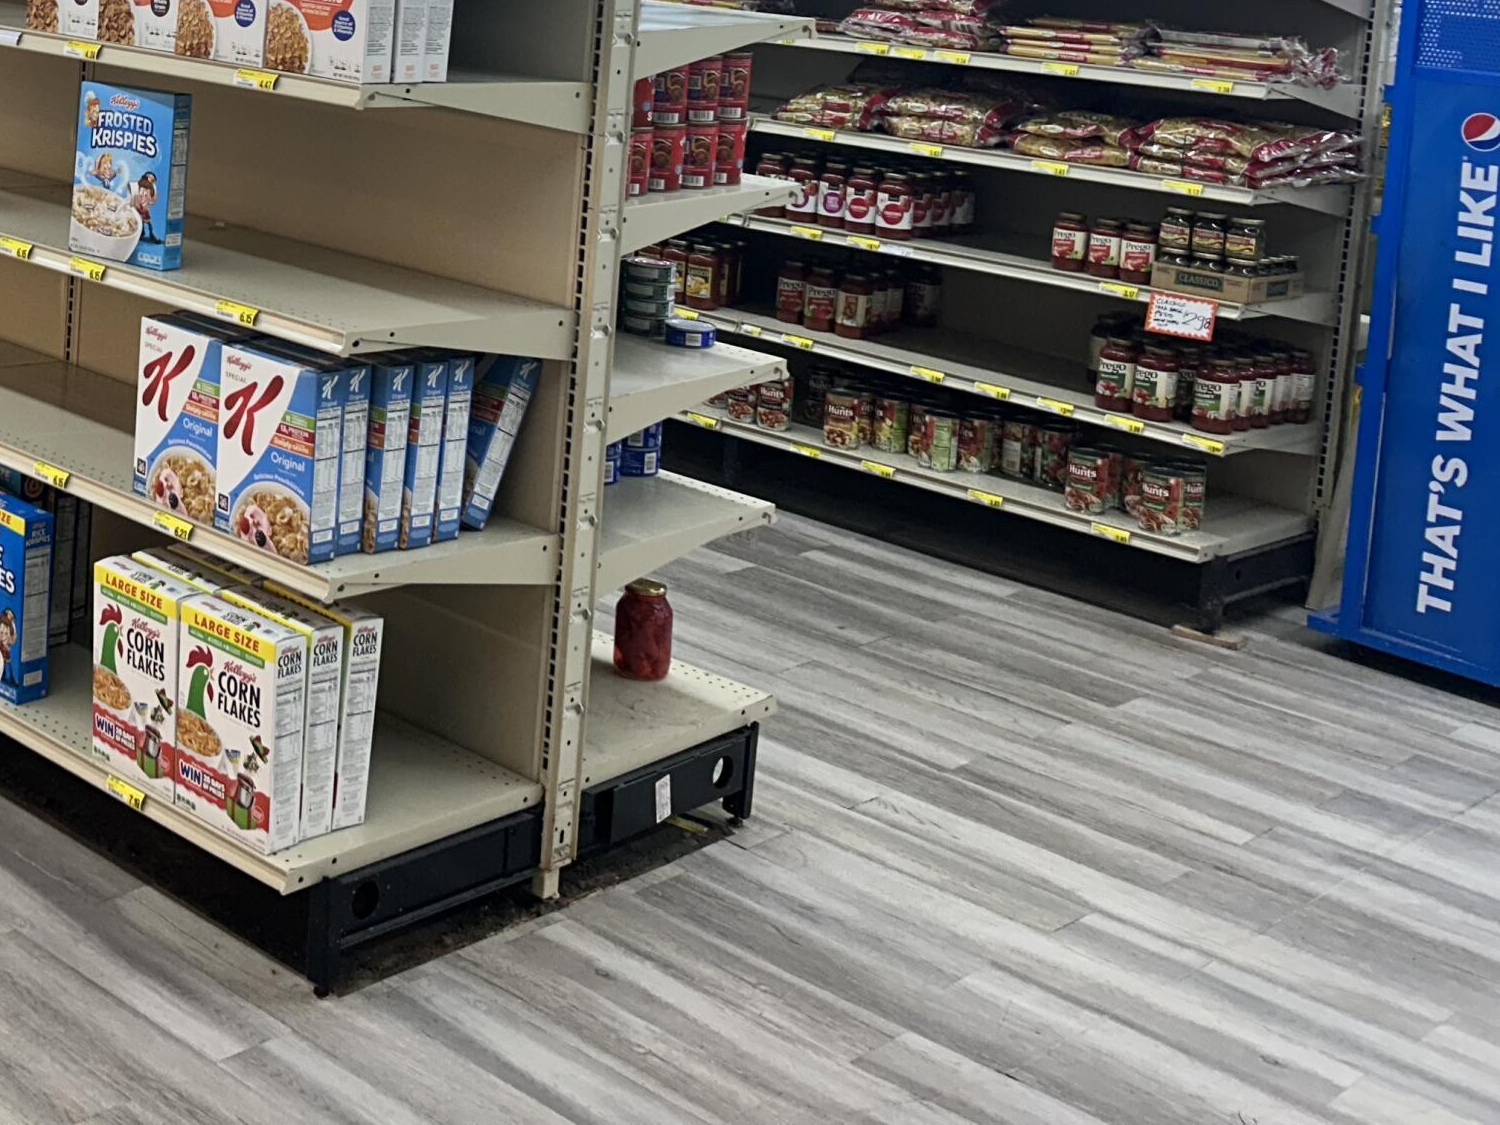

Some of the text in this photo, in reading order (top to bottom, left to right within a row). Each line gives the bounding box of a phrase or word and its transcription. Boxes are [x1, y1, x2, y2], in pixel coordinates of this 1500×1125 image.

[110, 94, 141, 110] Kellogg's
[97, 111, 152, 135] FROSTED
[91, 128, 157, 157] KRISPIES
[1126, 242, 1151, 251] Prego
[1178, 274, 1220, 288] CLASSICO
[145, 326, 168, 341] Kellogg's
[226, 354, 252, 371] Kellogg's
[1136, 367, 1158, 380] rego
[142, 344, 196, 422] K
[1416, 158, 1499, 615] THAT'S WHAT I LIKE
[182, 417, 213, 437] Original
[223, 375, 284, 456] K
[270, 451, 306, 473] Original
[105, 573, 138, 599] LARGE
[139, 589, 163, 610] SIZE
[131, 616, 161, 639] Kellogg's
[193, 614, 229, 640] LARGE
[232, 632, 260, 653] SIZE
[353, 631, 378, 647] CORN
[126, 627, 165, 664] CORN
[313, 640, 338, 657] CORN
[352, 644, 377, 658] FLAKES
[126, 649, 165, 682] FLAKES
[277, 650, 302, 668] CORN
[313, 653, 338, 667] FLAKES
[223, 660, 257, 683] Kellogg's
[277, 664, 302, 679] FLAKES
[218, 671, 261, 709] CORN
[217, 696, 261, 729] FLAKES
[95, 715, 114, 738] WIN
[179, 761, 202, 786] WIN
